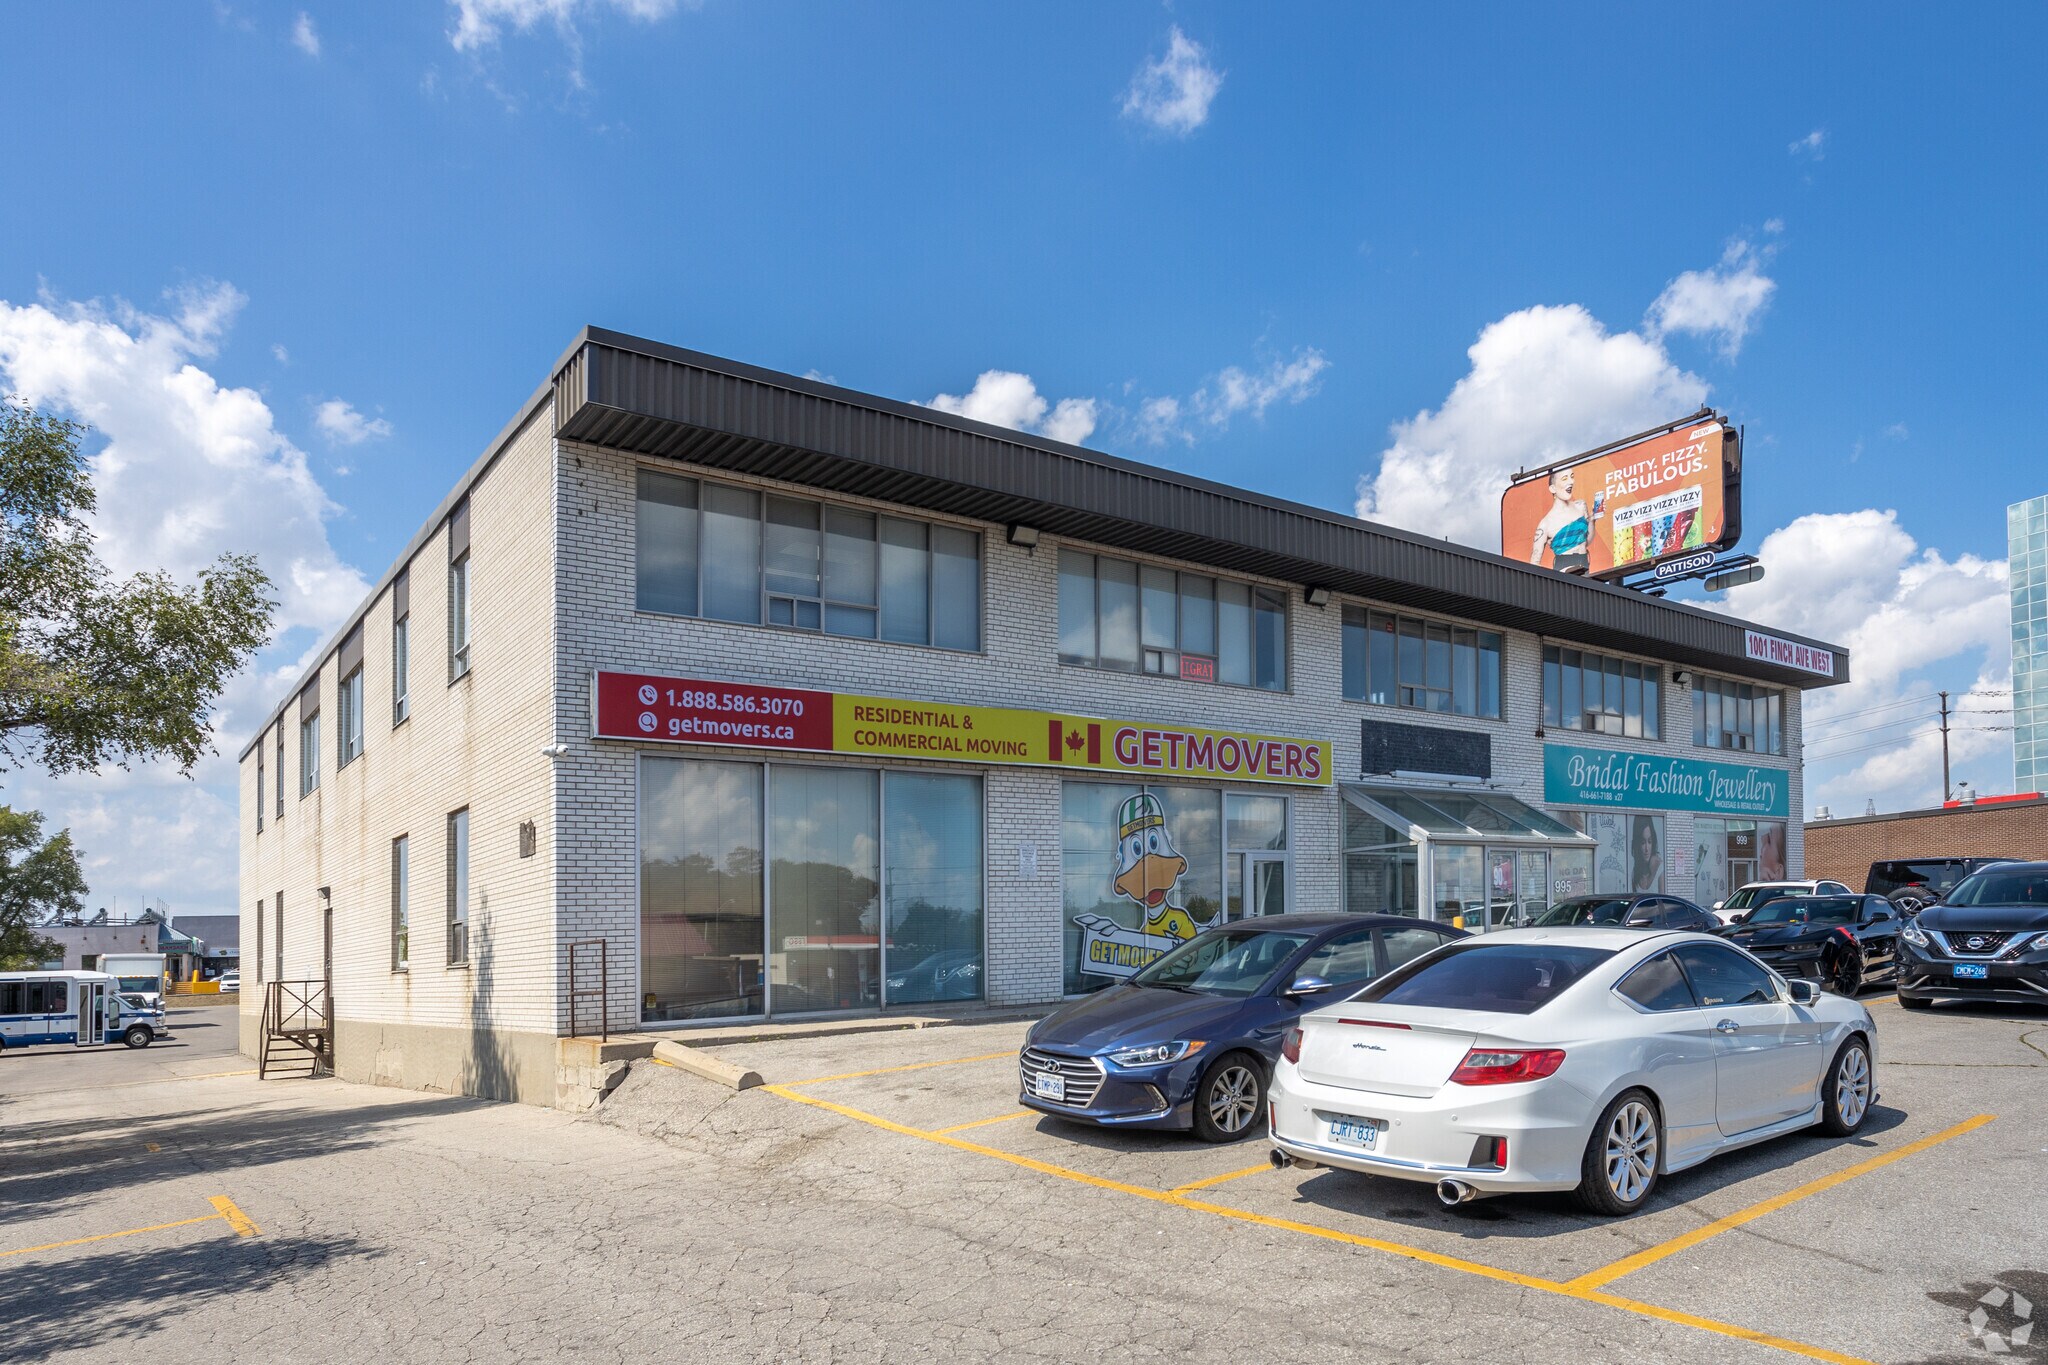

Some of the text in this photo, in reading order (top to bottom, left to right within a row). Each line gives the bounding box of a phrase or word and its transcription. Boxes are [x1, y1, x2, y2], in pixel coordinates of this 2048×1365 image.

[1693, 427, 1710, 438] NEW
[1605, 442, 1708, 484] FRUITY. FIZZY.
[1605, 457, 1709, 500] FABULOUS.
[1653, 496, 1680, 510] VIZZY
[1680, 490, 1701, 502] IZZY
[1659, 554, 1711, 576] PATTISON
[1749, 634, 1830, 673] 1001 FINCH AVE WEST
[665, 689, 804, 717] 1.888.586.3070
[668, 716, 795, 740] getmovers.ca
[854, 705, 973, 730] RESIDENTIAL &
[853, 730, 1027, 756] COMMERCIAL MOVING
[1113, 725, 1322, 780] GETMOVERS
[1568, 754, 1776, 812] Bridal Fashion Jewellery
[1736, 835, 1748, 845] 999
[1555, 880, 1572, 893] 995
[1168, 919, 1179, 932] G
[1330, 1119, 1375, 1142] CJRT 833
